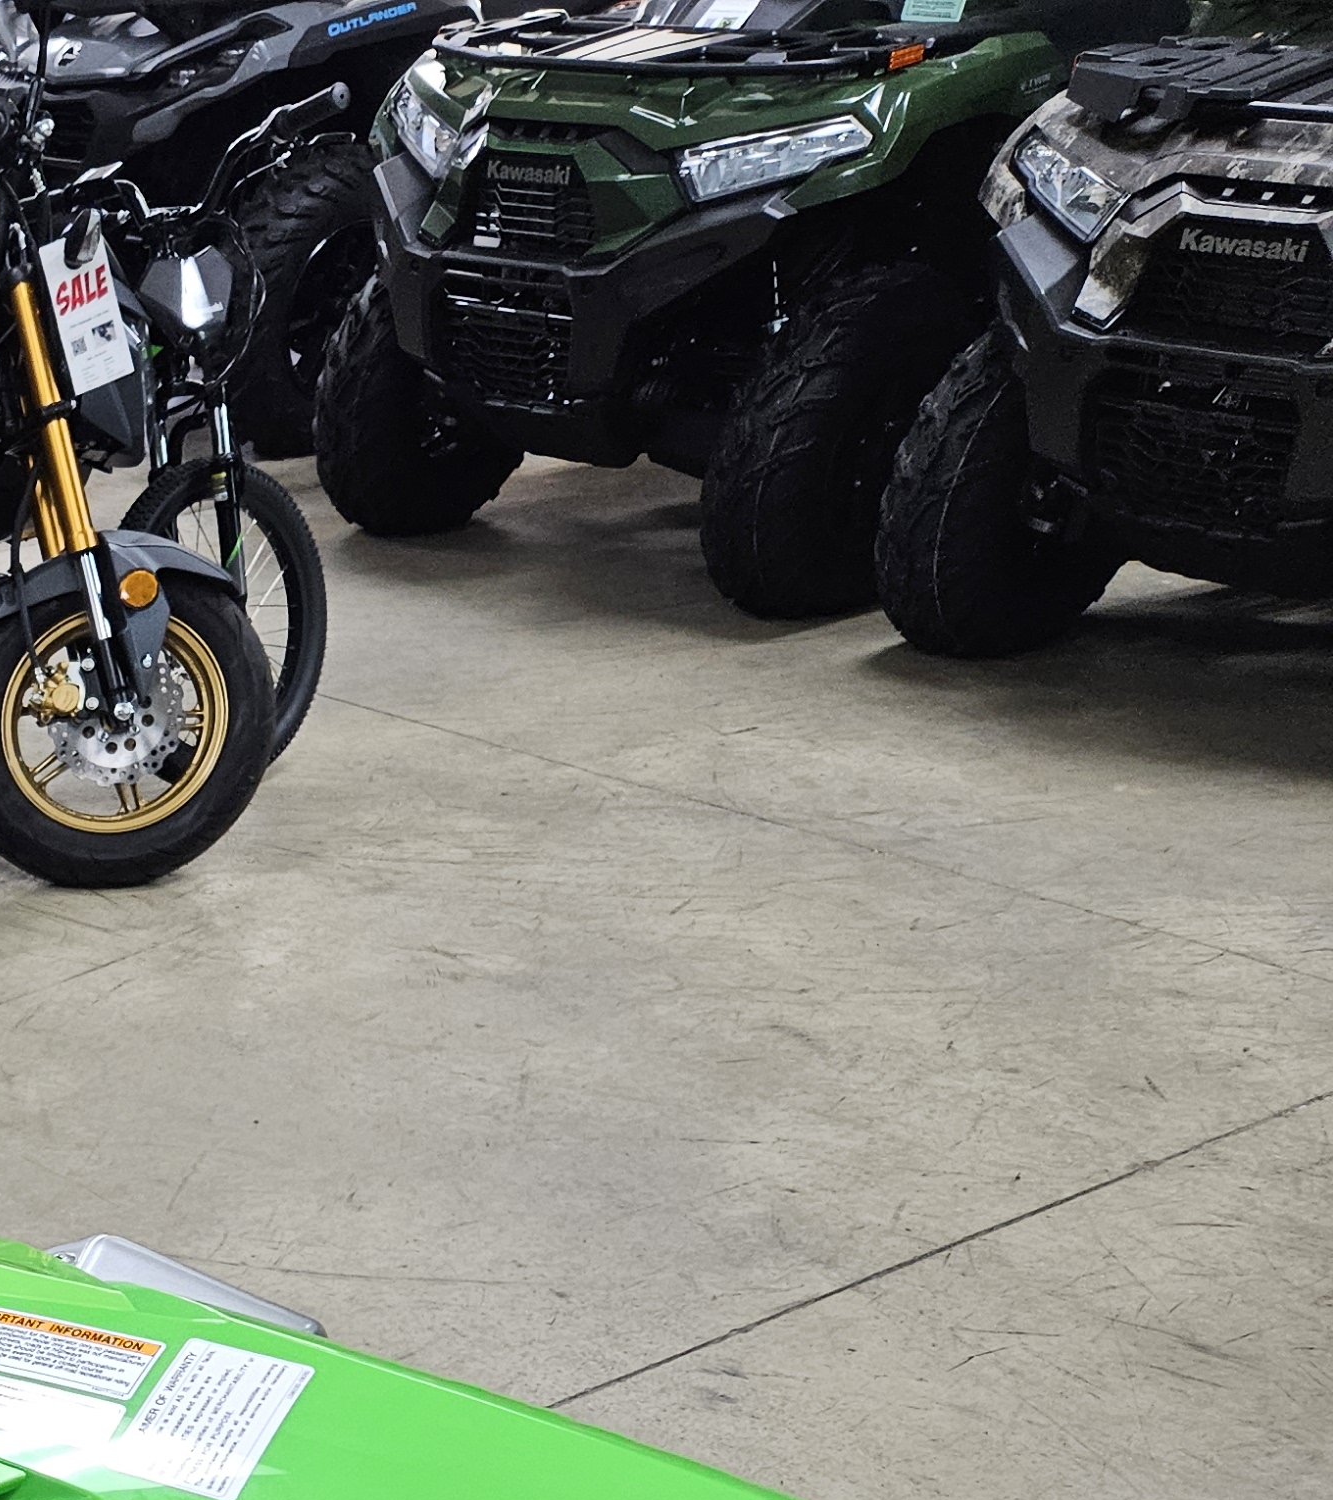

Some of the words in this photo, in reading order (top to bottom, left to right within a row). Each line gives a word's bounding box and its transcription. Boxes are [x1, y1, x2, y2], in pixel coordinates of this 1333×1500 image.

[327, 2, 417, 37] OUTLANDER
[487, 160, 571, 185] Kawasaki
[1179, 227, 1310, 262] Kawasaki
[56, 264, 108, 316] SALE
[49, 1324, 145, 1351] INFORMATION
[154, 1394, 169, 1405] OF
[163, 1351, 198, 1392] WARRANTY
